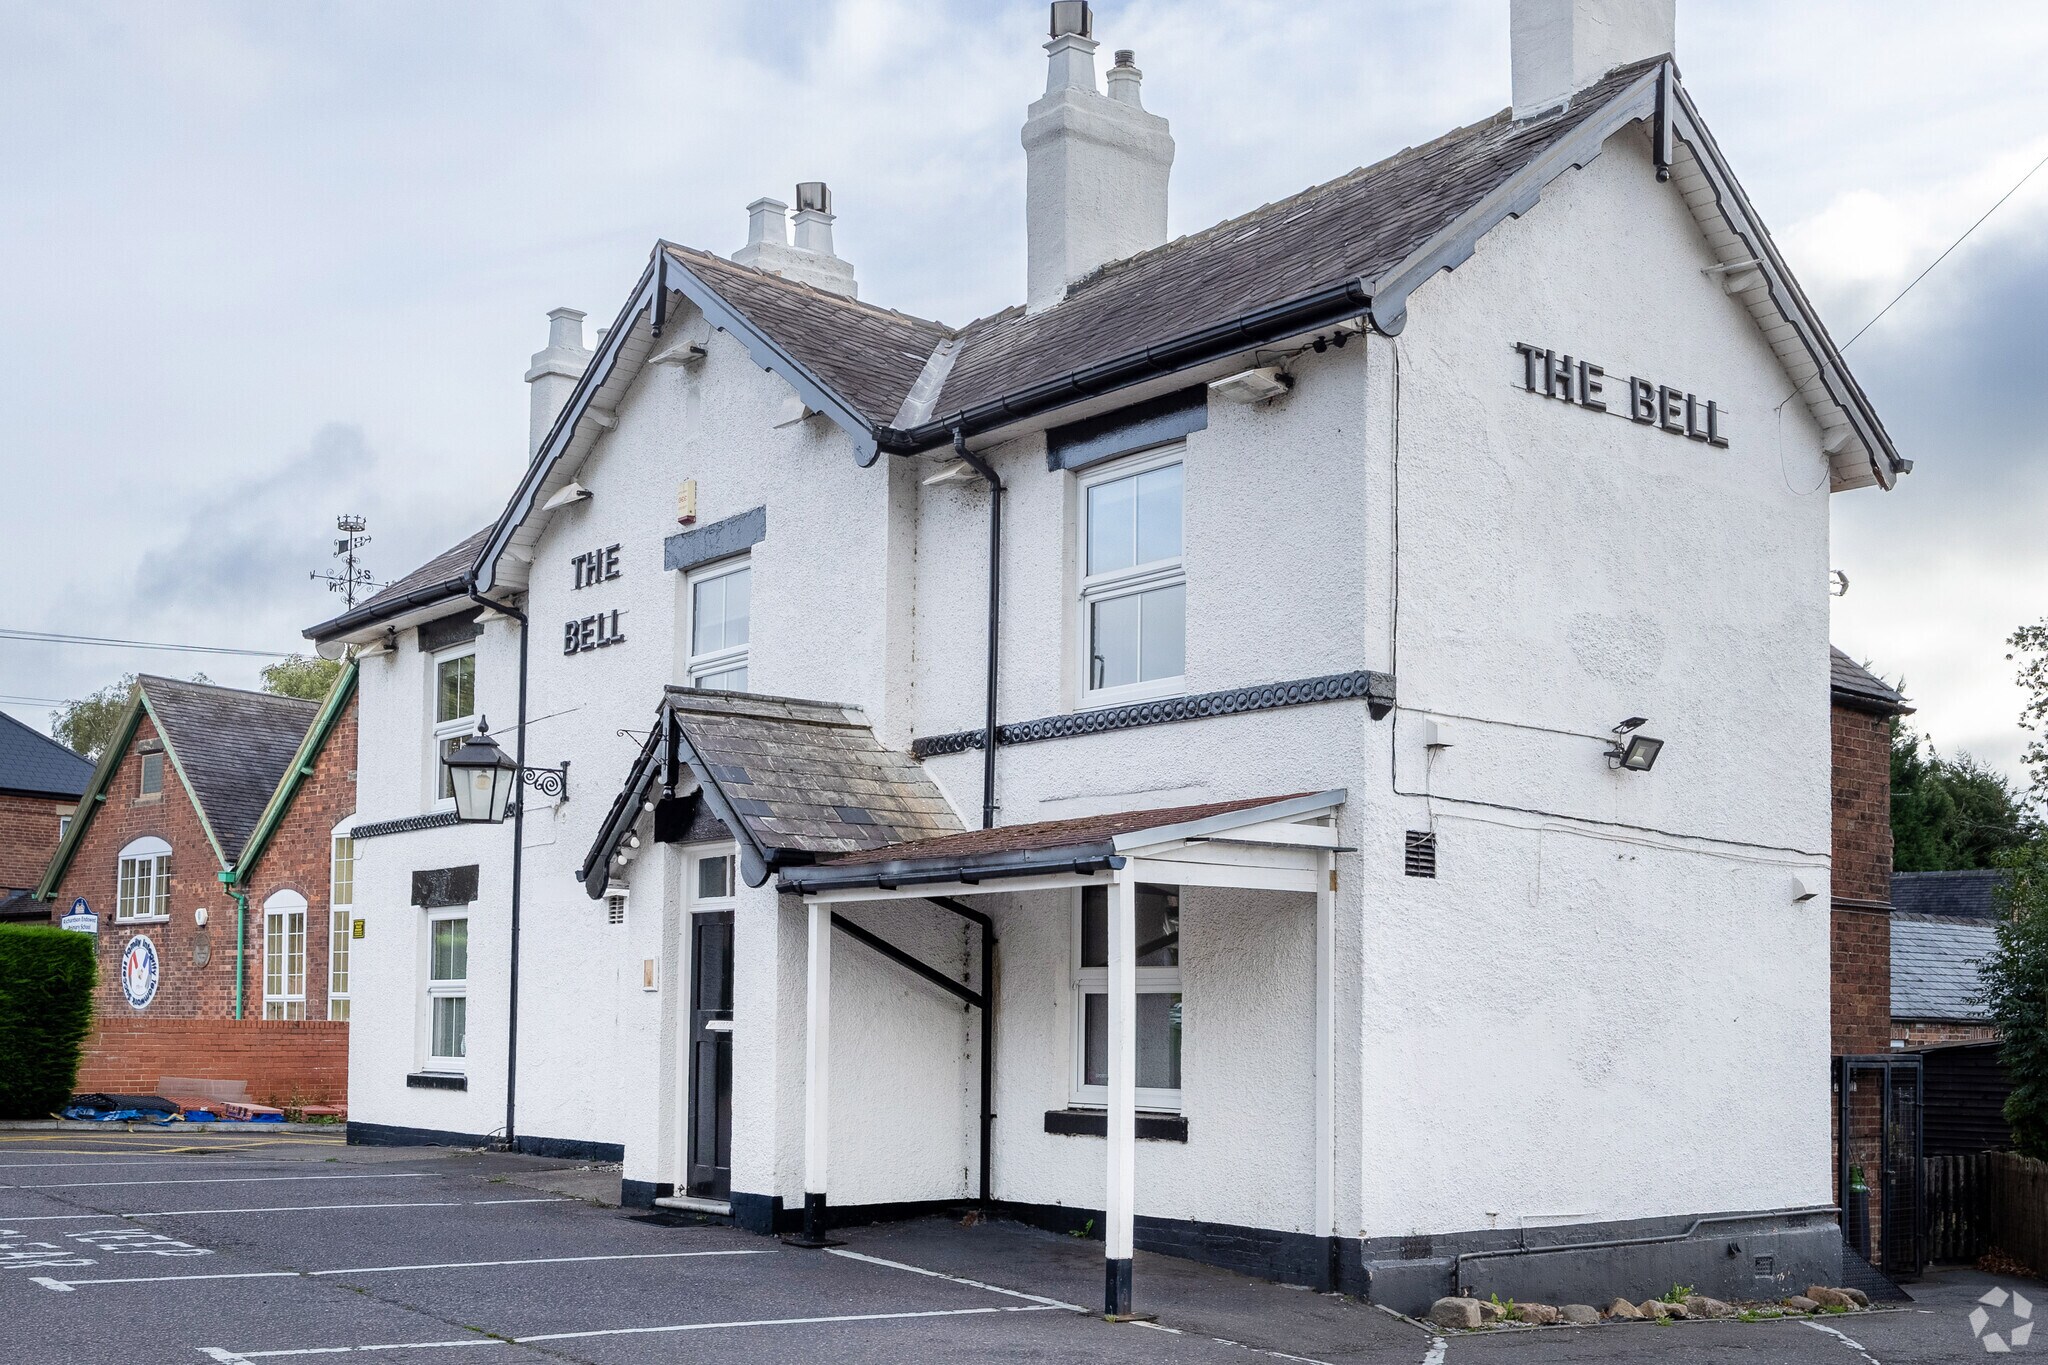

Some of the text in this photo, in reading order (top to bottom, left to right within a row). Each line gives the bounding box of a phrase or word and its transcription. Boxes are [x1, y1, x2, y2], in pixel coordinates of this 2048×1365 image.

[1516, 341, 1729, 449] THE BELL
[571, 543, 622, 591] THE
[564, 608, 627, 656] BELL
[142, 939, 157, 976] Integrity
[132, 979, 157, 1006] Teamwork
[63, 1228, 215, 1257] KEEP
